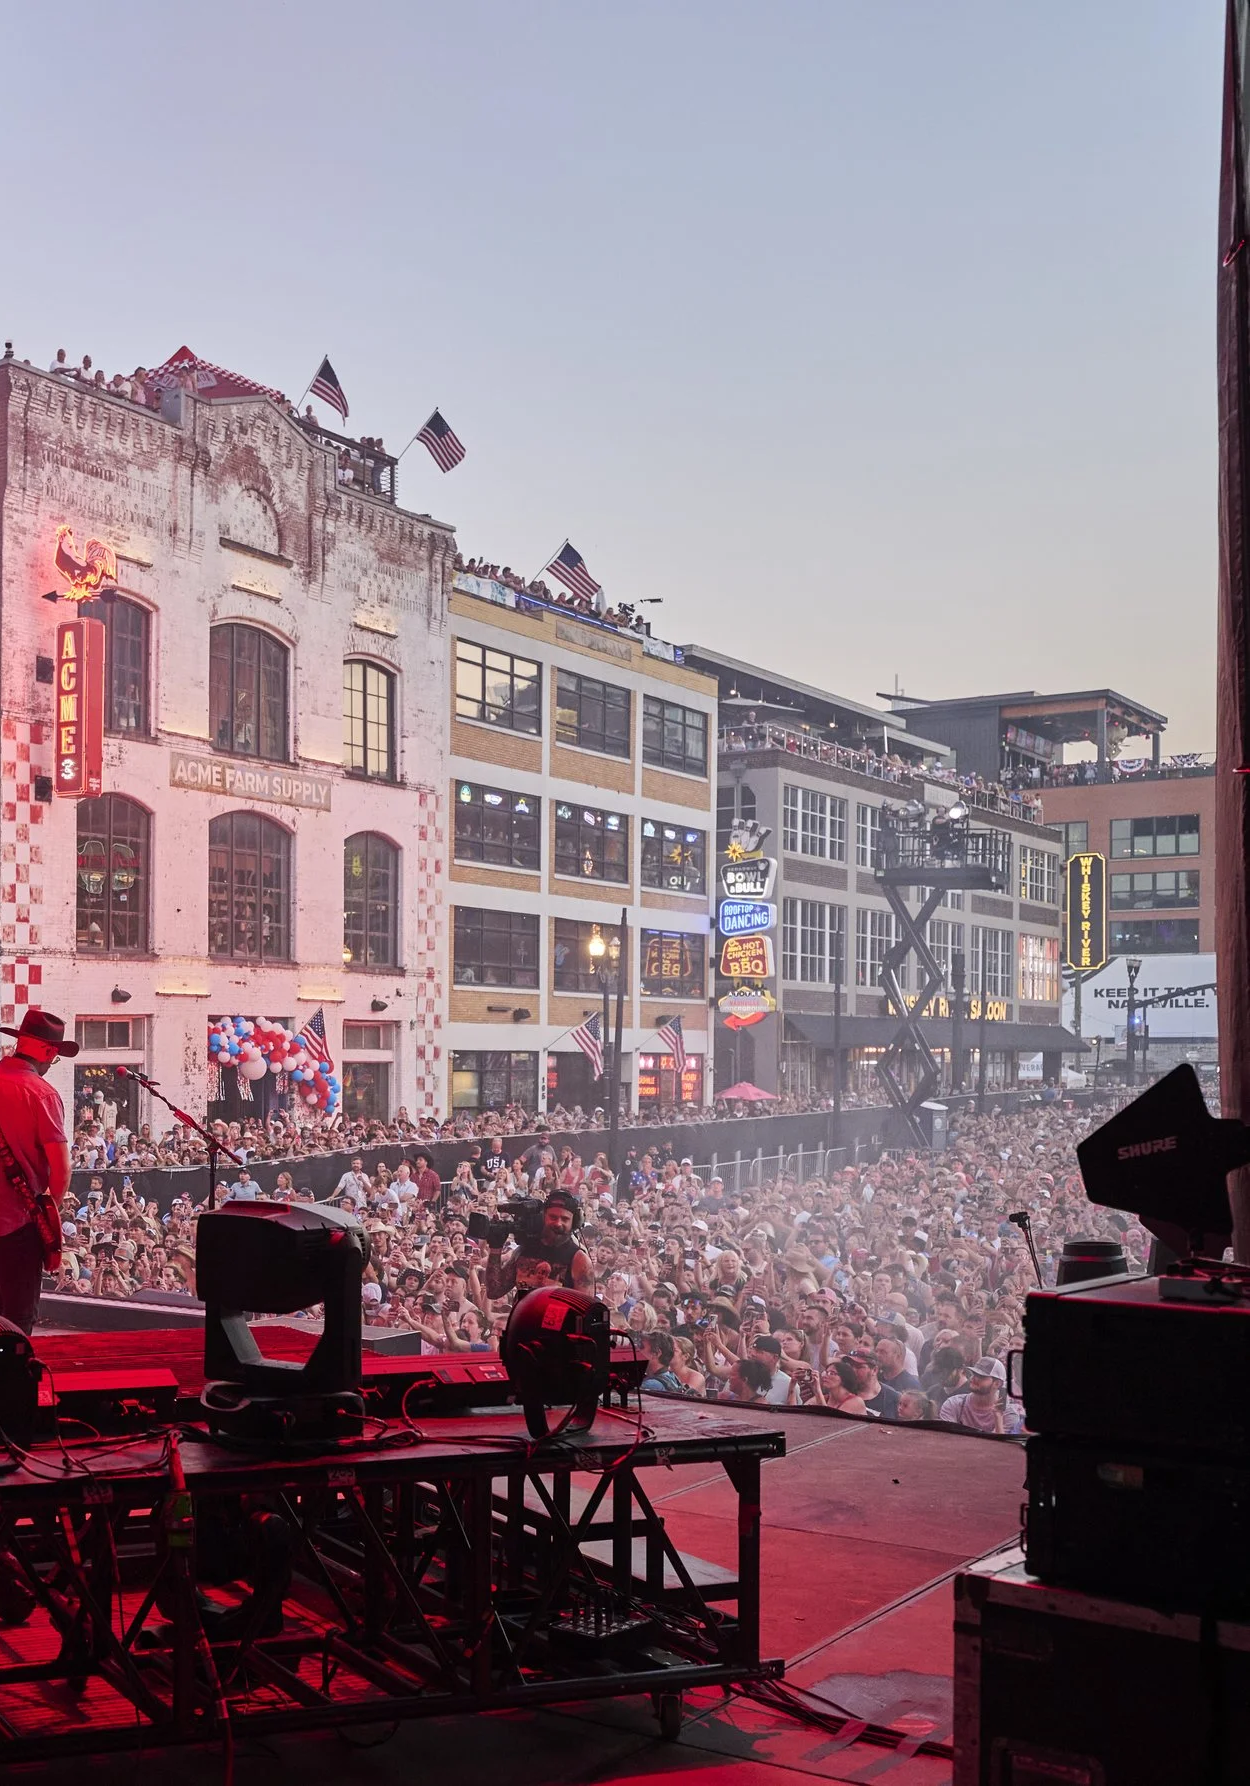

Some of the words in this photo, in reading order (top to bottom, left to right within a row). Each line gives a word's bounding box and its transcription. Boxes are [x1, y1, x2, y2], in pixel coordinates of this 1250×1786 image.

[59, 630, 78, 755] ACME
[174, 759, 222, 787] ACME
[225, 767, 269, 794] FARM
[272, 777, 329, 804] SUPPLY
[726, 871, 764, 884] BOWL
[1079, 857, 1093, 919] WHISKEY
[724, 904, 754, 916] ROOFTOP
[724, 911, 768, 931] DANCING
[742, 940, 761, 950] HOT
[1081, 921, 1091, 966] RIVER
[726, 948, 763, 960] CHICKEN
[729, 960, 764, 975] BBQ
[1143, 987, 1159, 997] IT
[1117, 1136, 1179, 1160] SHURE
[486, 1158, 506, 1169] USA
